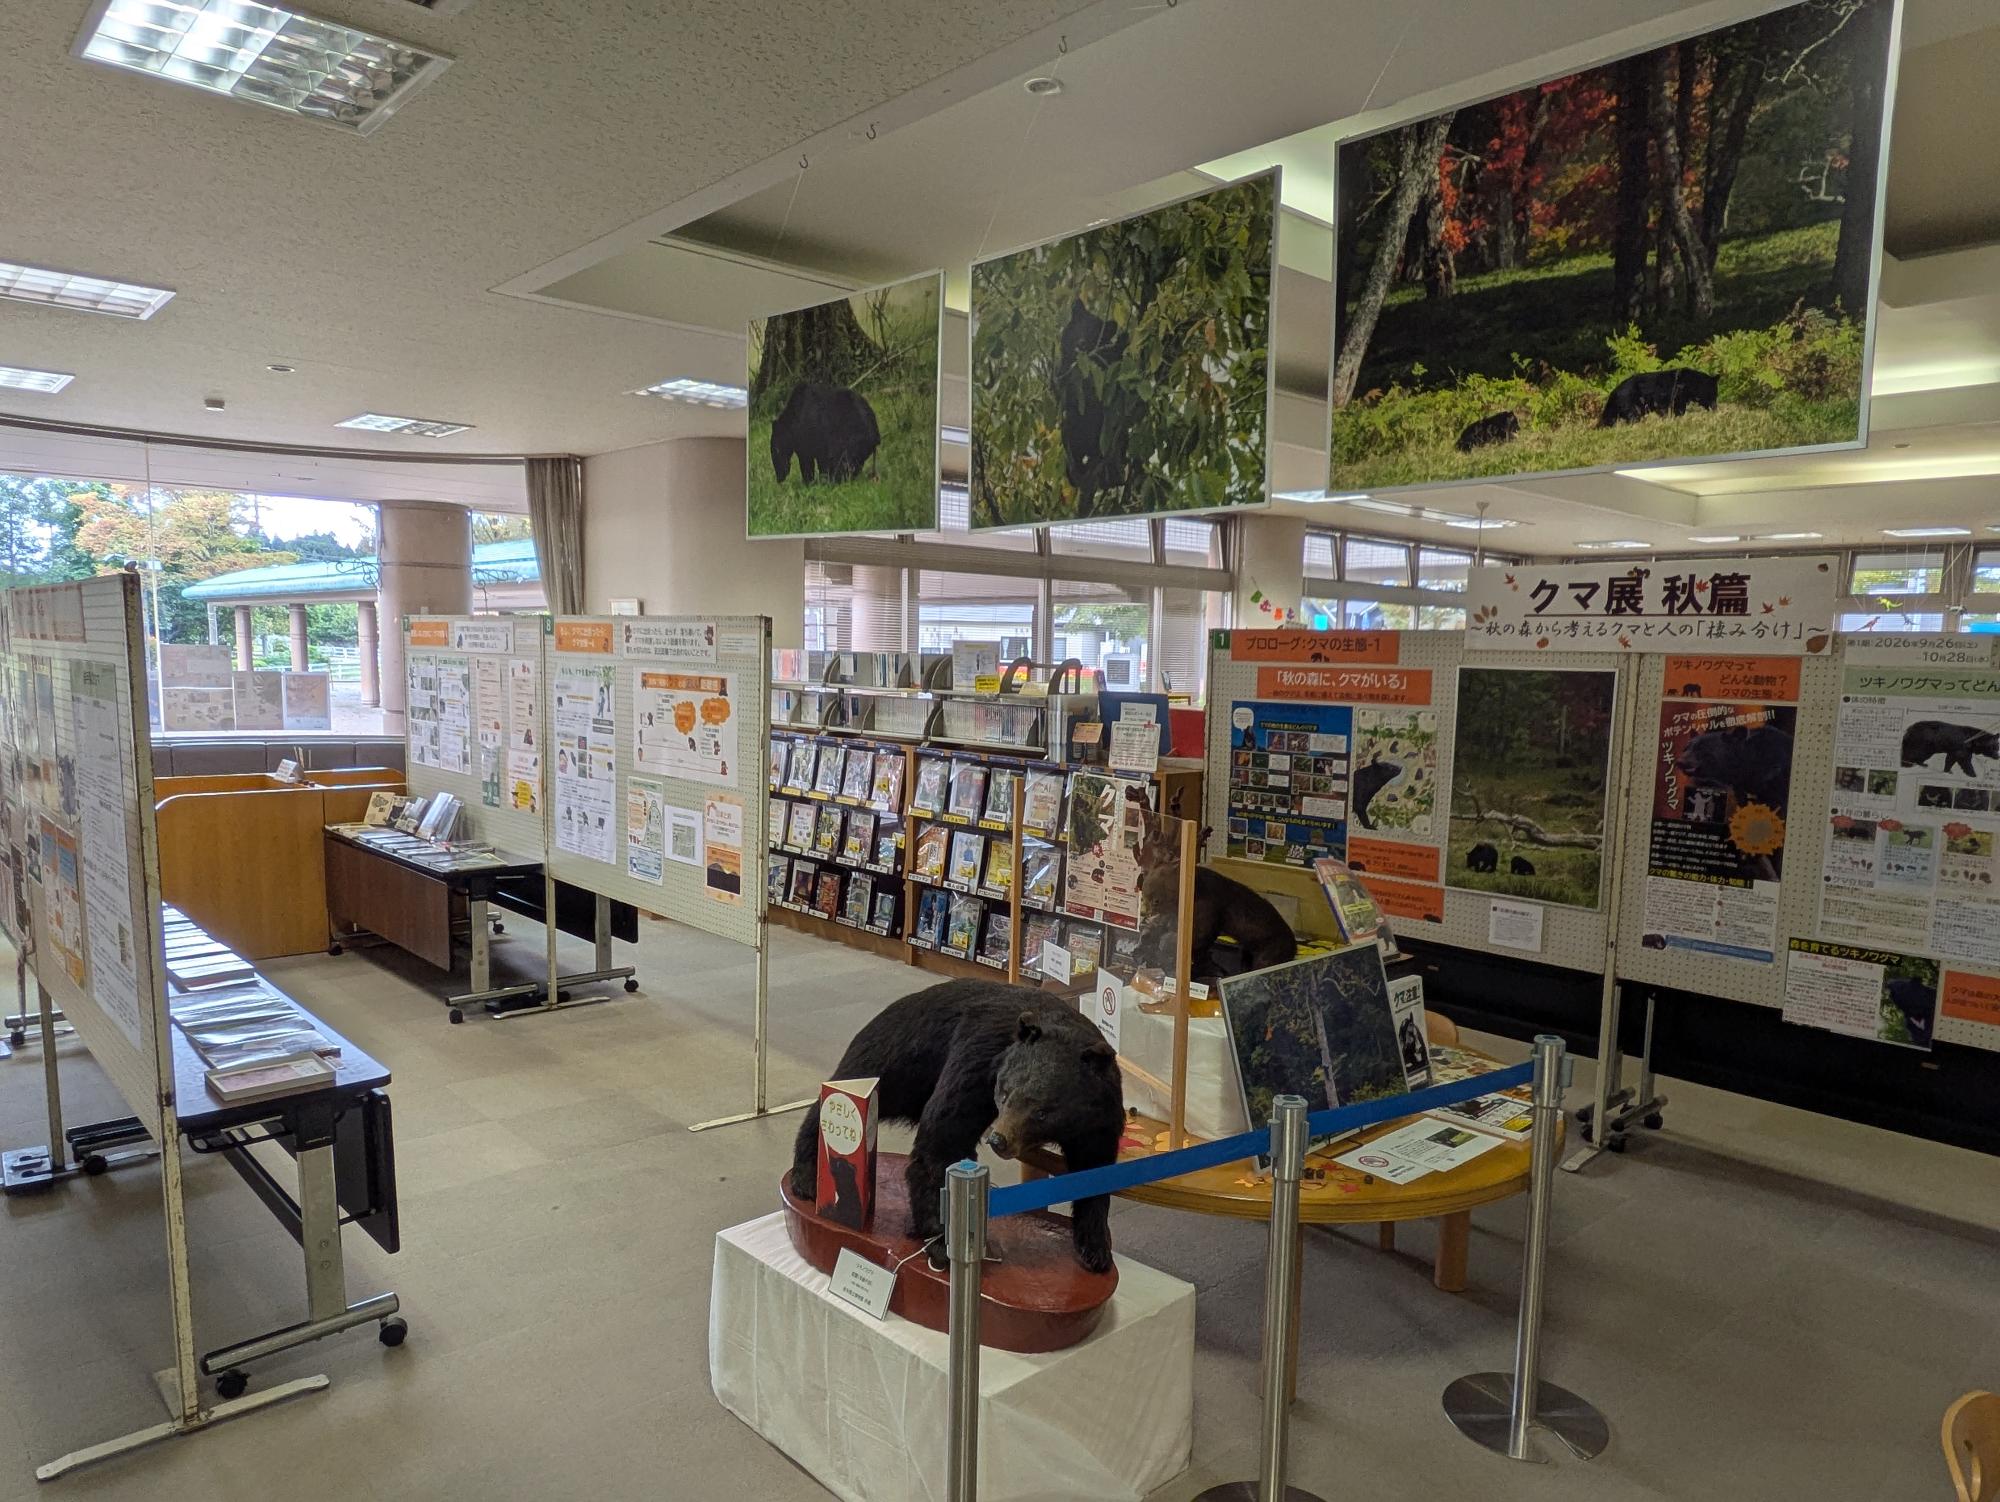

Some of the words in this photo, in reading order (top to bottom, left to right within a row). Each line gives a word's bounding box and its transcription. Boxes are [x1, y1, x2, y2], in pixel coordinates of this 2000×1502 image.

[1529, 576, 1644, 615] クマ展
[1661, 572, 1751, 615] 秋篇
[1219, 632, 1226, 646] 1
[1673, 660, 1757, 671] ツキノワグマって
[1661, 741, 1679, 811] ツキノワグマ
[1097, 783, 1117, 836] クマ
